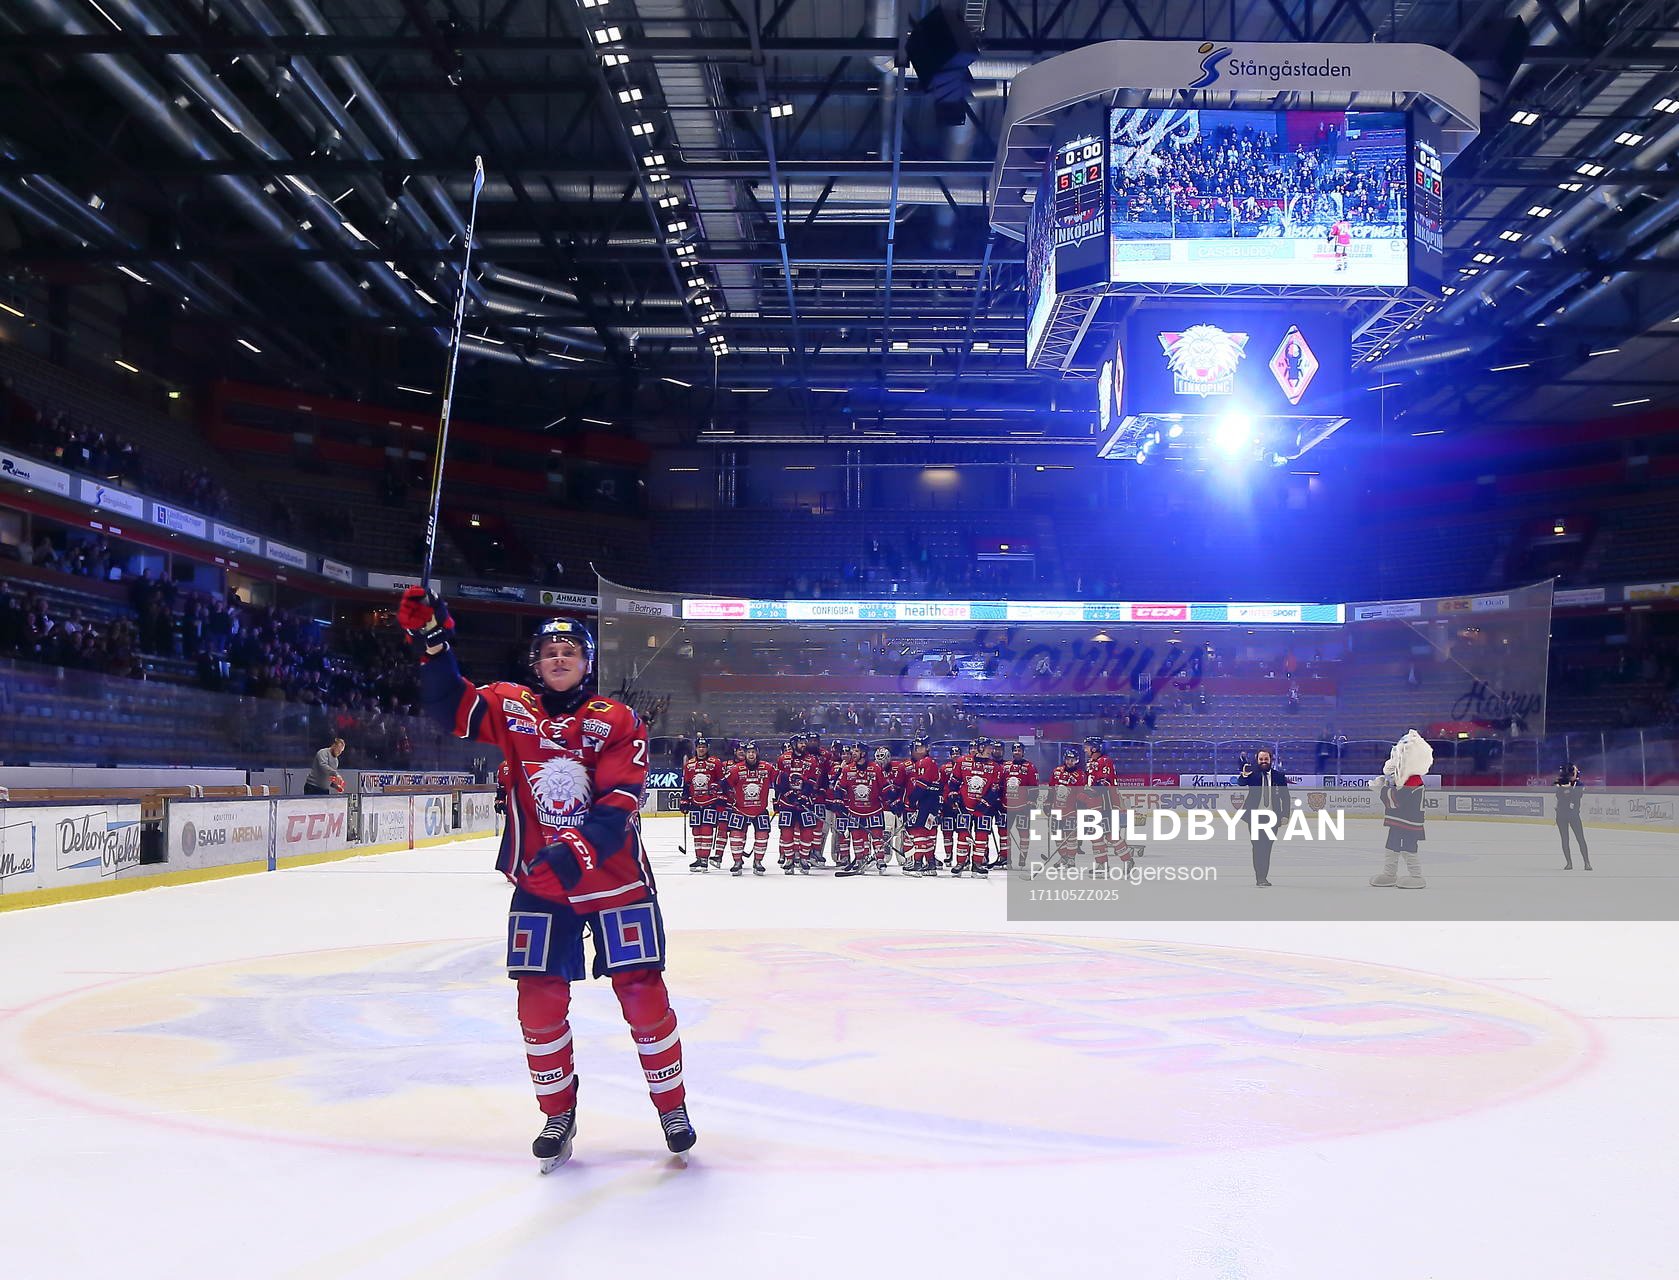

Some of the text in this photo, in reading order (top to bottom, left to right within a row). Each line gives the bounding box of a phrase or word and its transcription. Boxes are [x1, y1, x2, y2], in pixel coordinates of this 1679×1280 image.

[1228, 59, 1351, 80] Stångåstaden
[1065, 142, 1101, 165] 0:00
[1420, 150, 1442, 174] 0:00
[1061, 175, 1069, 189] 5
[1089, 166, 1098, 180] 2
[812, 606, 854, 615] CONFIGURA
[904, 604, 967, 617] healthcare
[1136, 607, 1181, 616] CCM
[1329, 795, 1371, 805] Linköping
[286, 812, 344, 843] CCM
[539, 810, 585, 826] LINKÖPING
[60, 818, 105, 854] Dekor
[198, 826, 263, 847] SAAB ARENA
[561, 831, 594, 869] CCM
